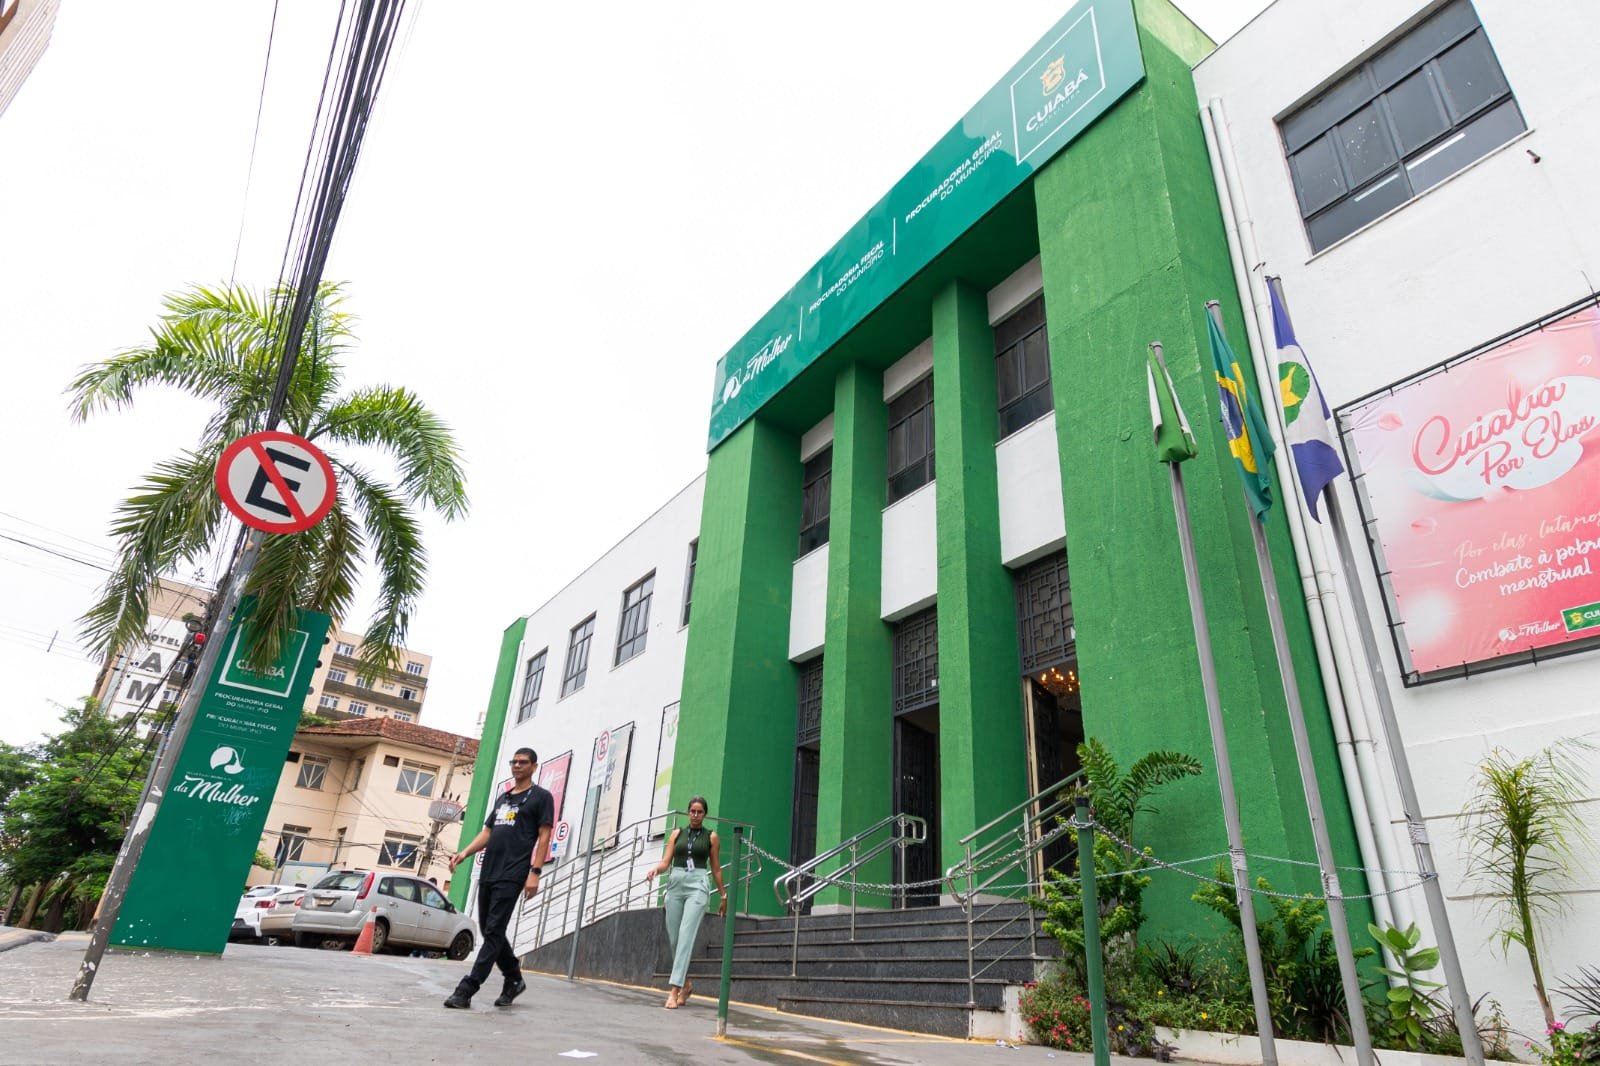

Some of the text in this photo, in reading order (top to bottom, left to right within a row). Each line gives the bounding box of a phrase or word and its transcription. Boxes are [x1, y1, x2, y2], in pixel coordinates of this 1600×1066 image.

[1026, 68, 1089, 132] CUIABÁ
[905, 130, 1002, 224] PROCURADORIA GERAL
[940, 139, 1003, 201] DO MUNICÍPIO
[809, 240, 885, 314] PROCURADORIA FISCAL
[836, 249, 884, 297] DO MUNICÍPIO
[747, 333, 793, 380] Mulher
[1465, 410, 1596, 486] Por Elas
[245, 447, 312, 518] E
[1454, 540, 1487, 565] Por
[1455, 554, 1534, 589] Combate
[1537, 549, 1553, 565] à
[1499, 557, 1593, 597] menstrual
[1521, 620, 1561, 637] Mulher
[235, 658, 286, 679] CUBÁ
[214, 692, 284, 711] PROCURADORIA GERAL
[173, 780, 189, 793] da
[184, 774, 260, 807] Mulher
[559, 826, 566, 838] E
